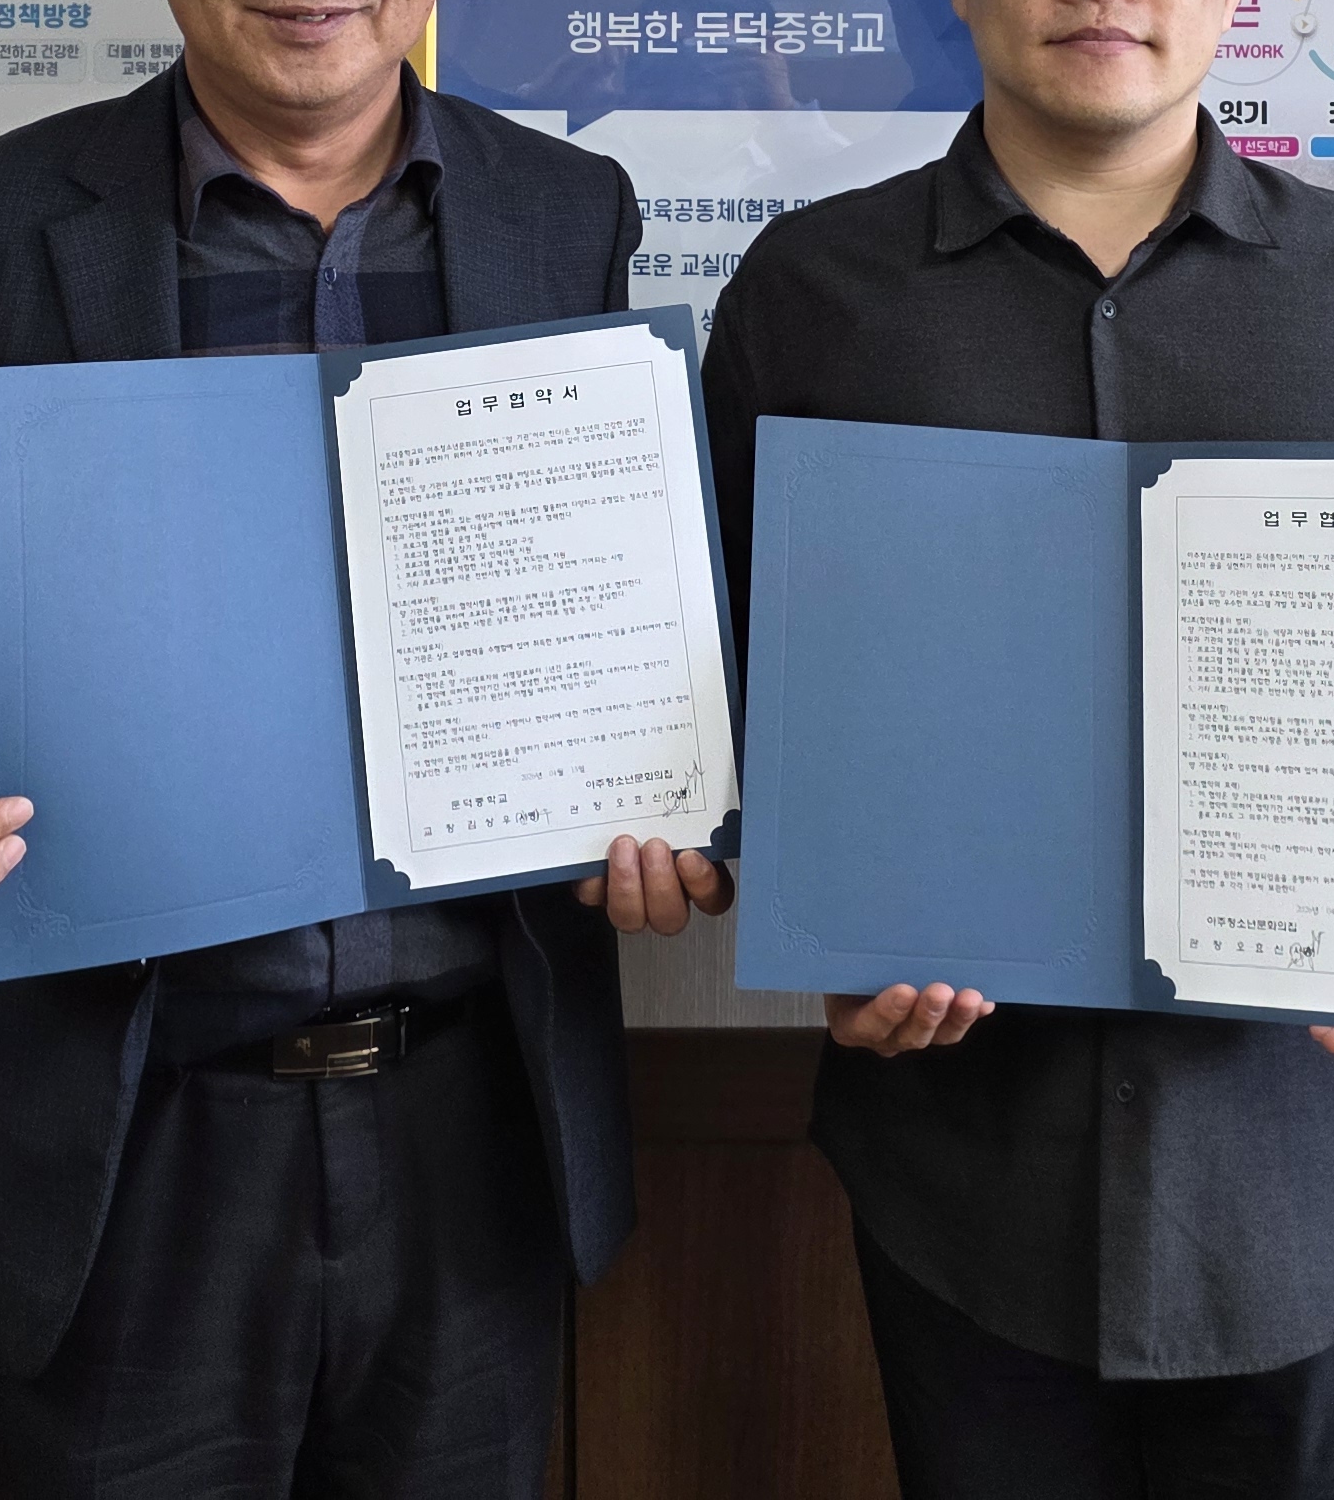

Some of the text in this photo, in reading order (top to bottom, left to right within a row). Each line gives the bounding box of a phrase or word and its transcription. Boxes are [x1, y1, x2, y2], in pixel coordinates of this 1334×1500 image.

[568, 11, 884, 54] 행복한 둔덕중학교
[1216, 101, 1267, 131] 잇기
